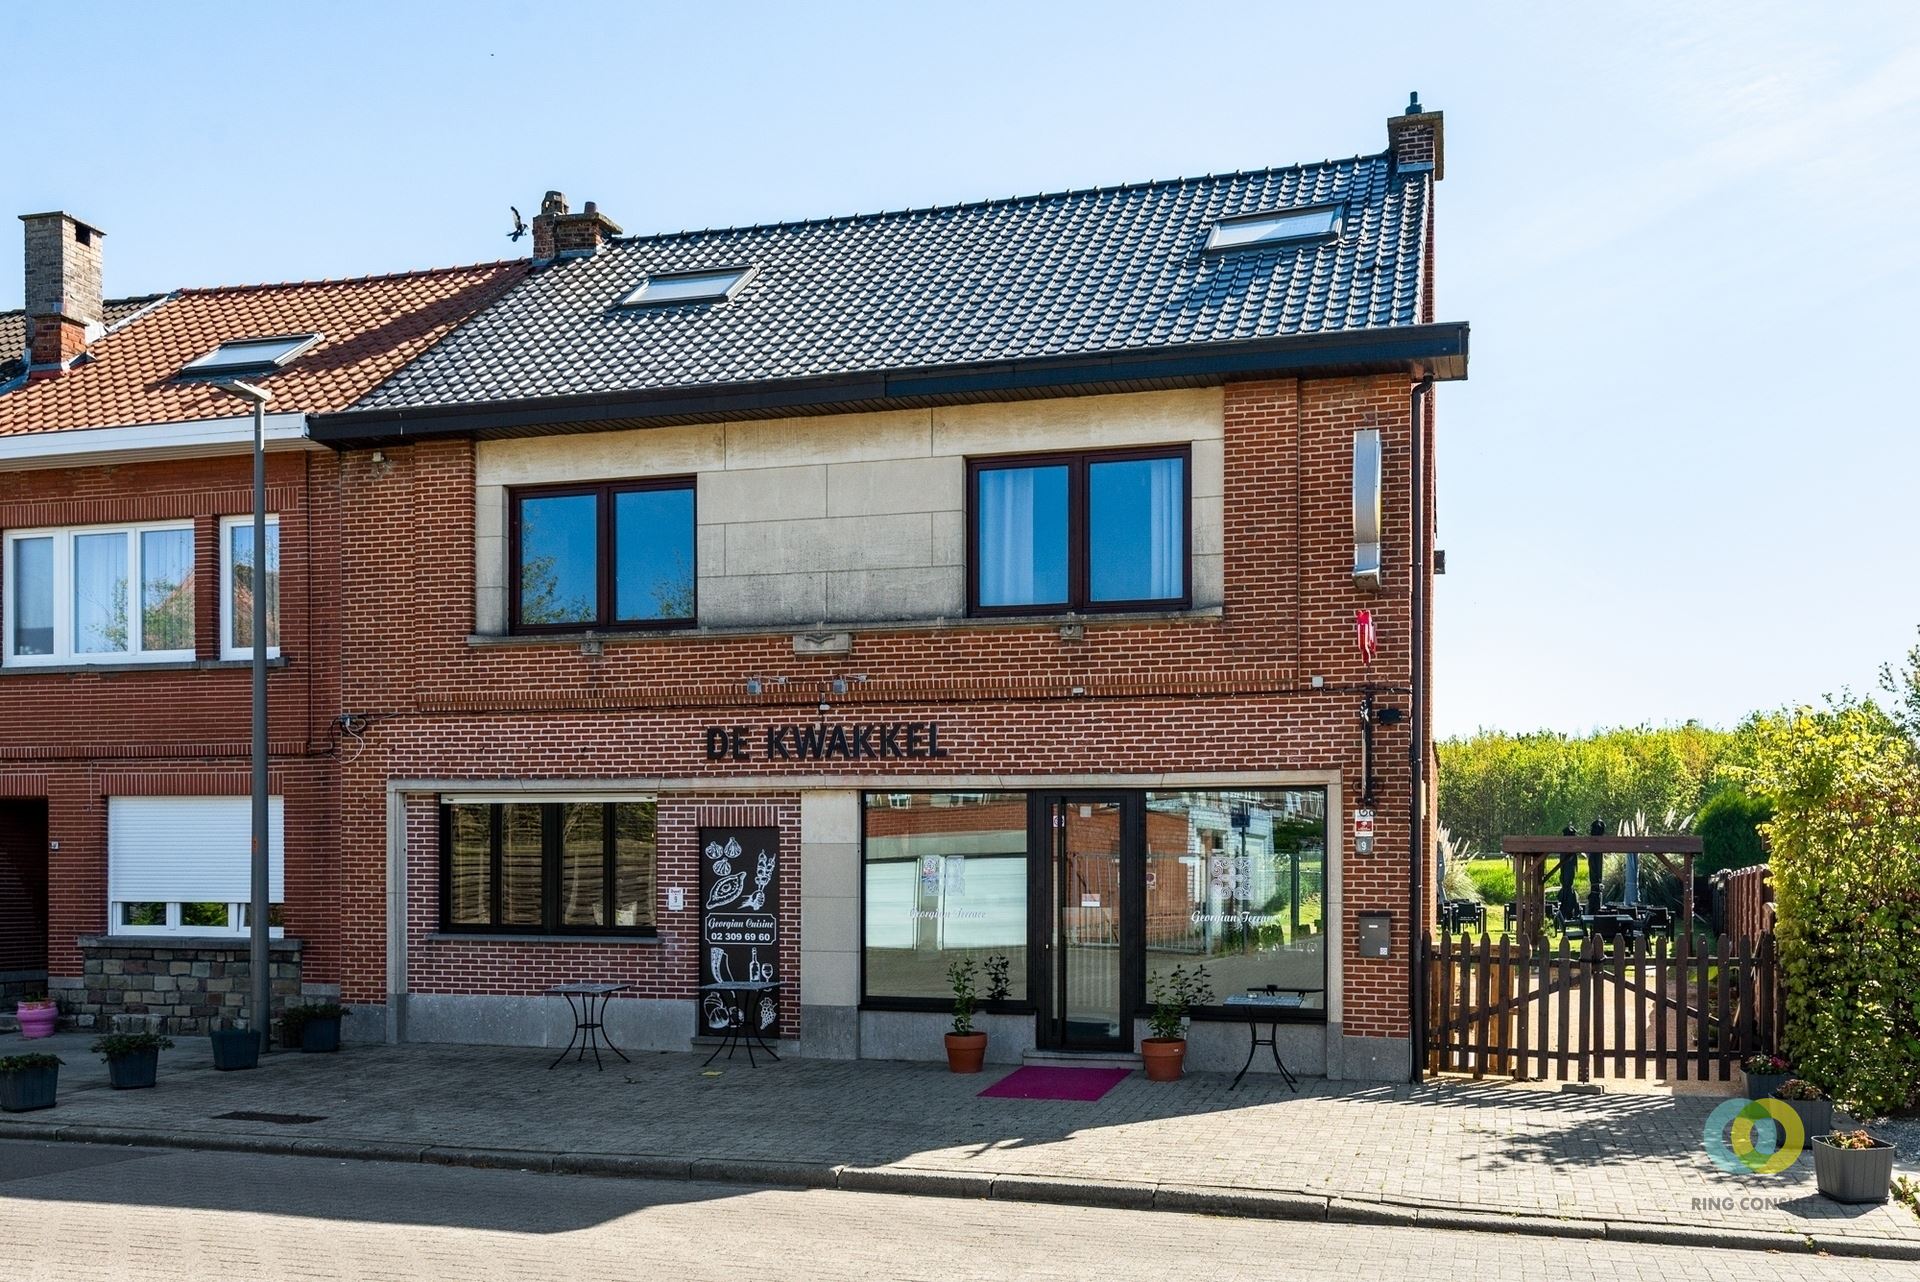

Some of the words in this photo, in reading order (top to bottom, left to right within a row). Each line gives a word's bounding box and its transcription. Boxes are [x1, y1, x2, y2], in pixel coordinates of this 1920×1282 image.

[707, 725, 750, 760] DE
[767, 721, 948, 760] KWAKKEL
[1361, 841, 1367, 851] 9
[708, 917, 744, 930] Georgian
[745, 918, 774, 929] Cuisine
[1191, 910, 1238, 924] Georgian
[711, 932, 723, 941] 02
[725, 932, 743, 941] 309
[744, 932, 756, 941] 69
[758, 933, 771, 941] 60
